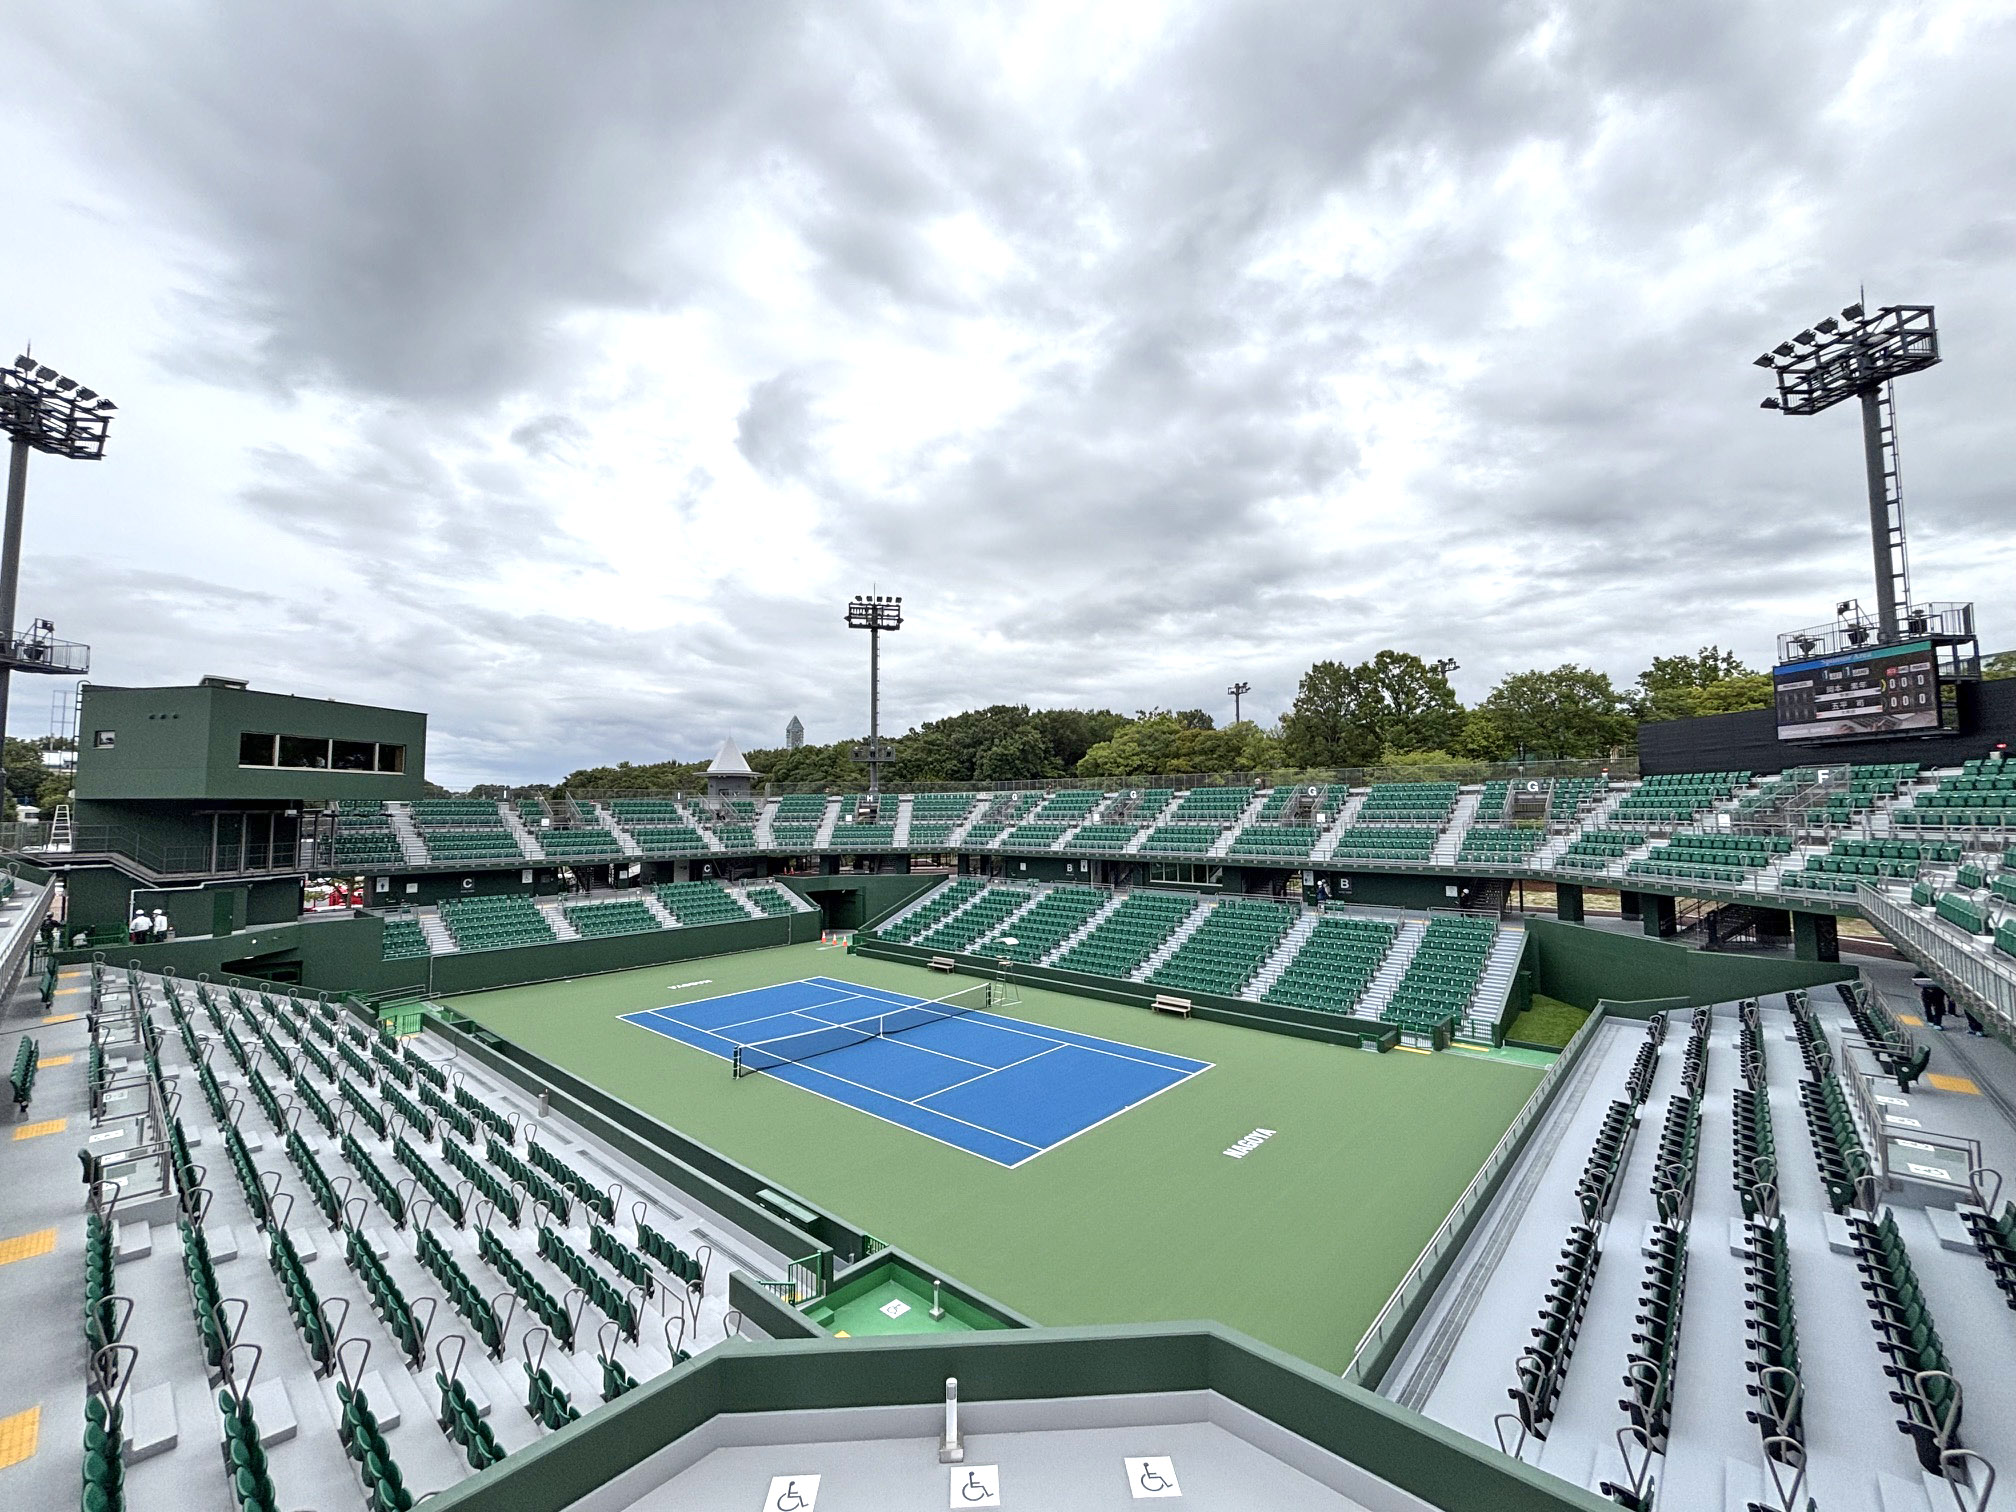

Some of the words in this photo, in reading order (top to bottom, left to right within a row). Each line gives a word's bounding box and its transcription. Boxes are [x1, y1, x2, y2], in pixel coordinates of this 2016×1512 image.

[1890, 679, 1896, 689] 0
[1901, 677, 1907, 687] 0
[1918, 675, 1924, 685] 0
[1891, 697, 1897, 707] 0
[1903, 695, 1909, 705] 0
[1919, 694, 1926, 704] 0
[1817, 769, 1830, 784] F
[1308, 786, 1318, 796] G
[1526, 780, 1539, 793] G
[1012, 793, 1018, 801] G
[1130, 790, 1138, 799] G
[704, 865, 711, 873] C
[1067, 864, 1073, 872] B
[463, 879, 472, 888] C
[1341, 879, 1349, 888] B
[1222, 1128, 1277, 1159] NAGOYA
